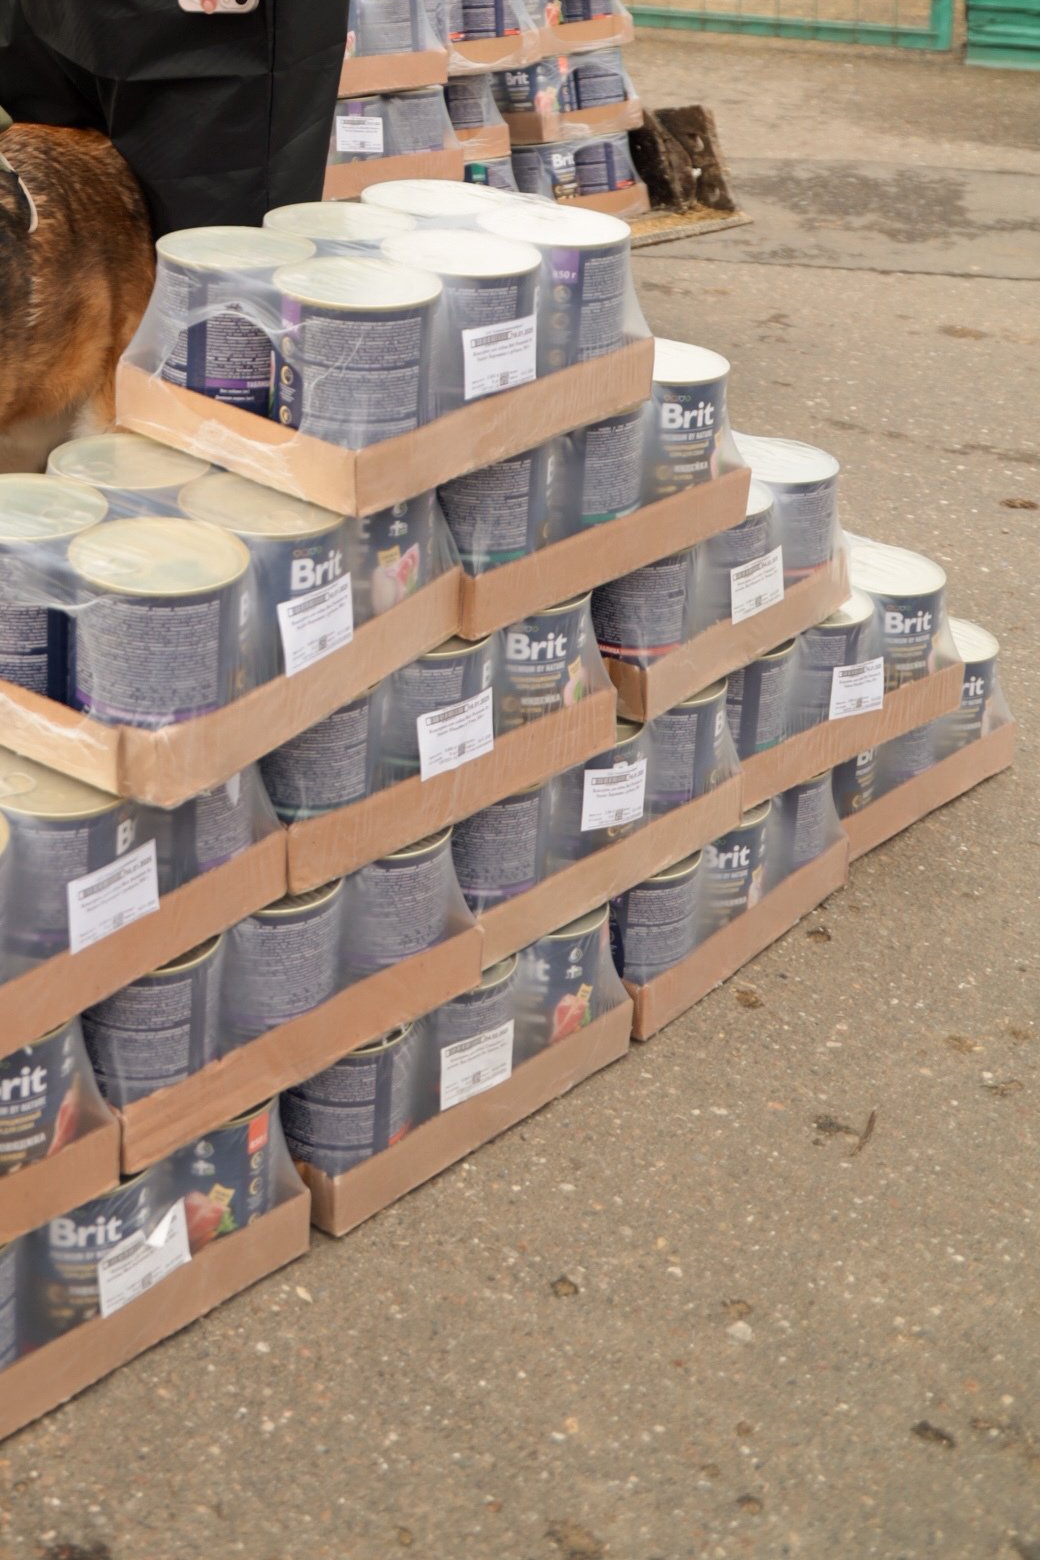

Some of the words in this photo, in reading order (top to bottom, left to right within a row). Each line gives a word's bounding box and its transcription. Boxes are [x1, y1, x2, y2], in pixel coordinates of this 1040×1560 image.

[661, 401, 715, 429] Brit
[291, 550, 342, 590] Brit
[885, 610, 932, 634] Brit
[507, 632, 567, 661] Brit
[704, 844, 750, 869] Brit
[49, 1215, 122, 1247] Brit
